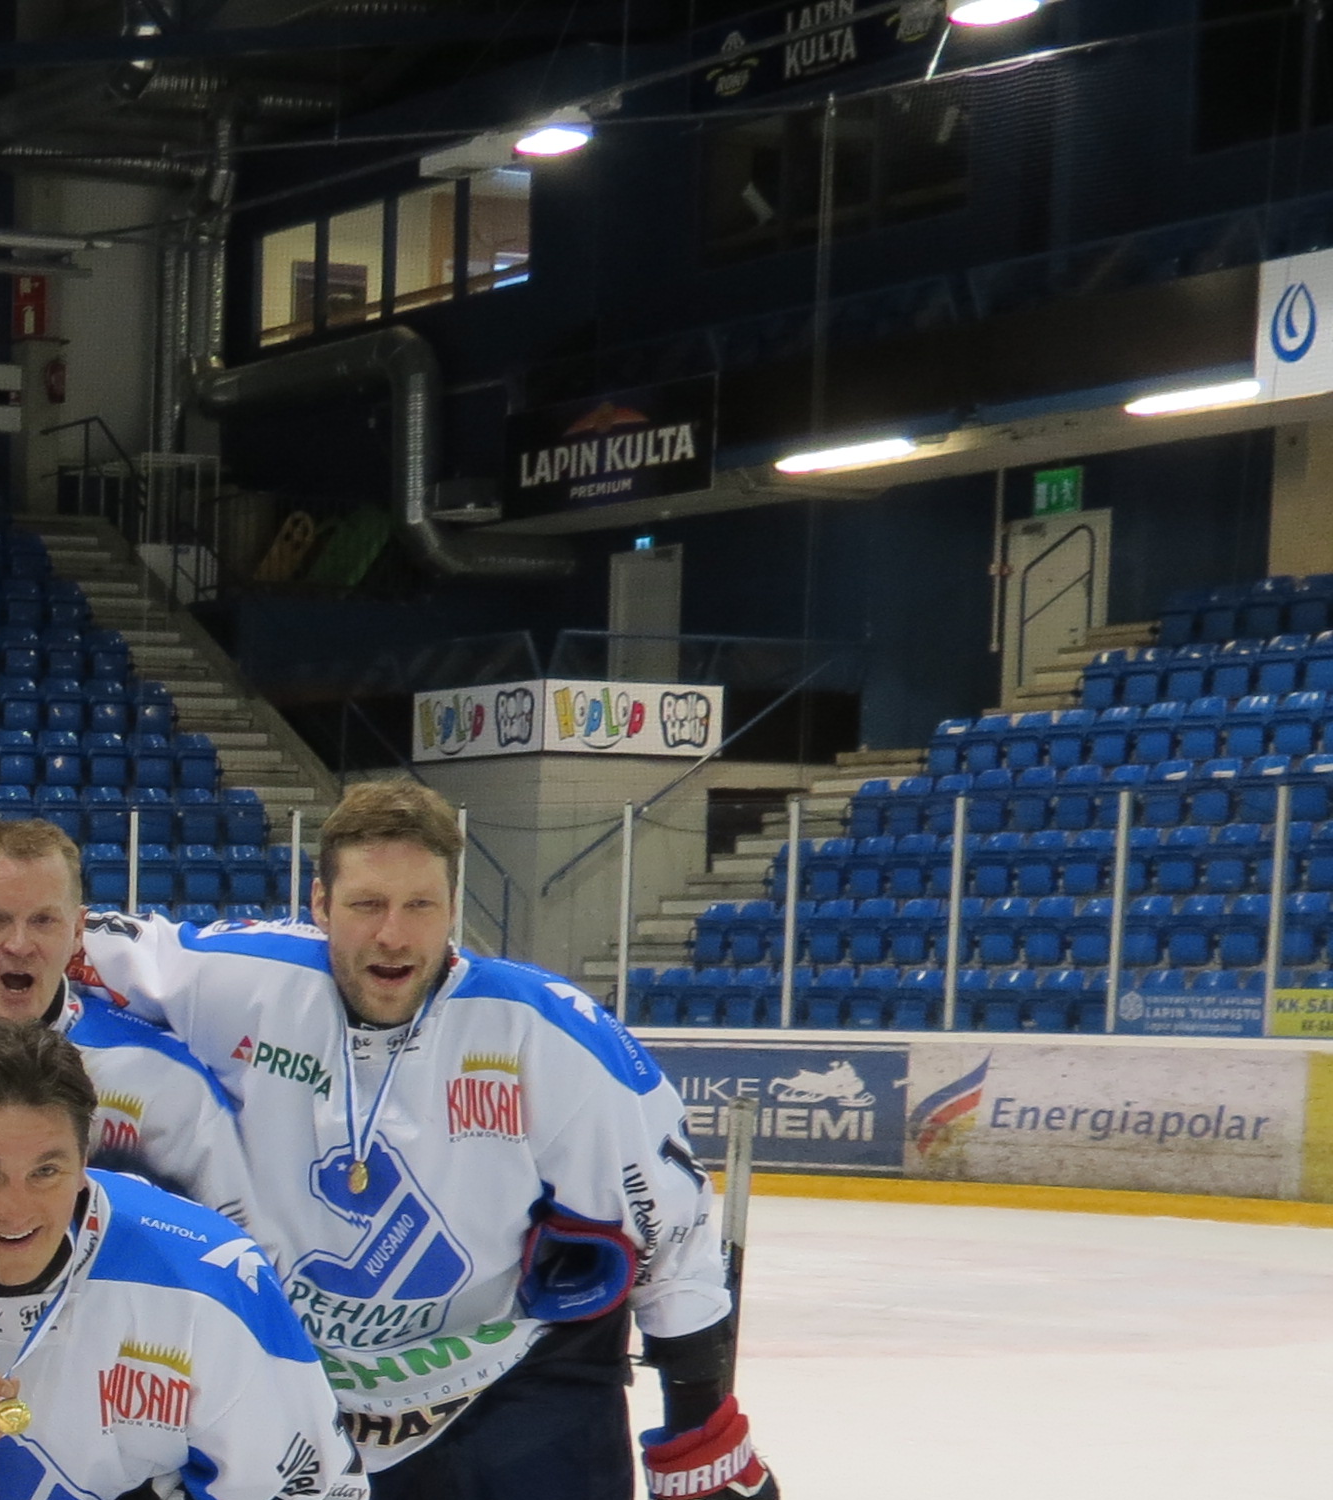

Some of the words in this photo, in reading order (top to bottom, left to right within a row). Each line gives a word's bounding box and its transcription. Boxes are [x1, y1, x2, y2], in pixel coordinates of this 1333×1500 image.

[784, 27, 856, 79] KULTA
[520, 438, 600, 489] LAPIN
[603, 422, 696, 474] KULTA
[569, 477, 633, 500] PREMIUM
[990, 1098, 1270, 1143] Energiapolar
[139, 1215, 209, 1244] KANTOLA
[362, 1212, 416, 1279] KUUSAMO
